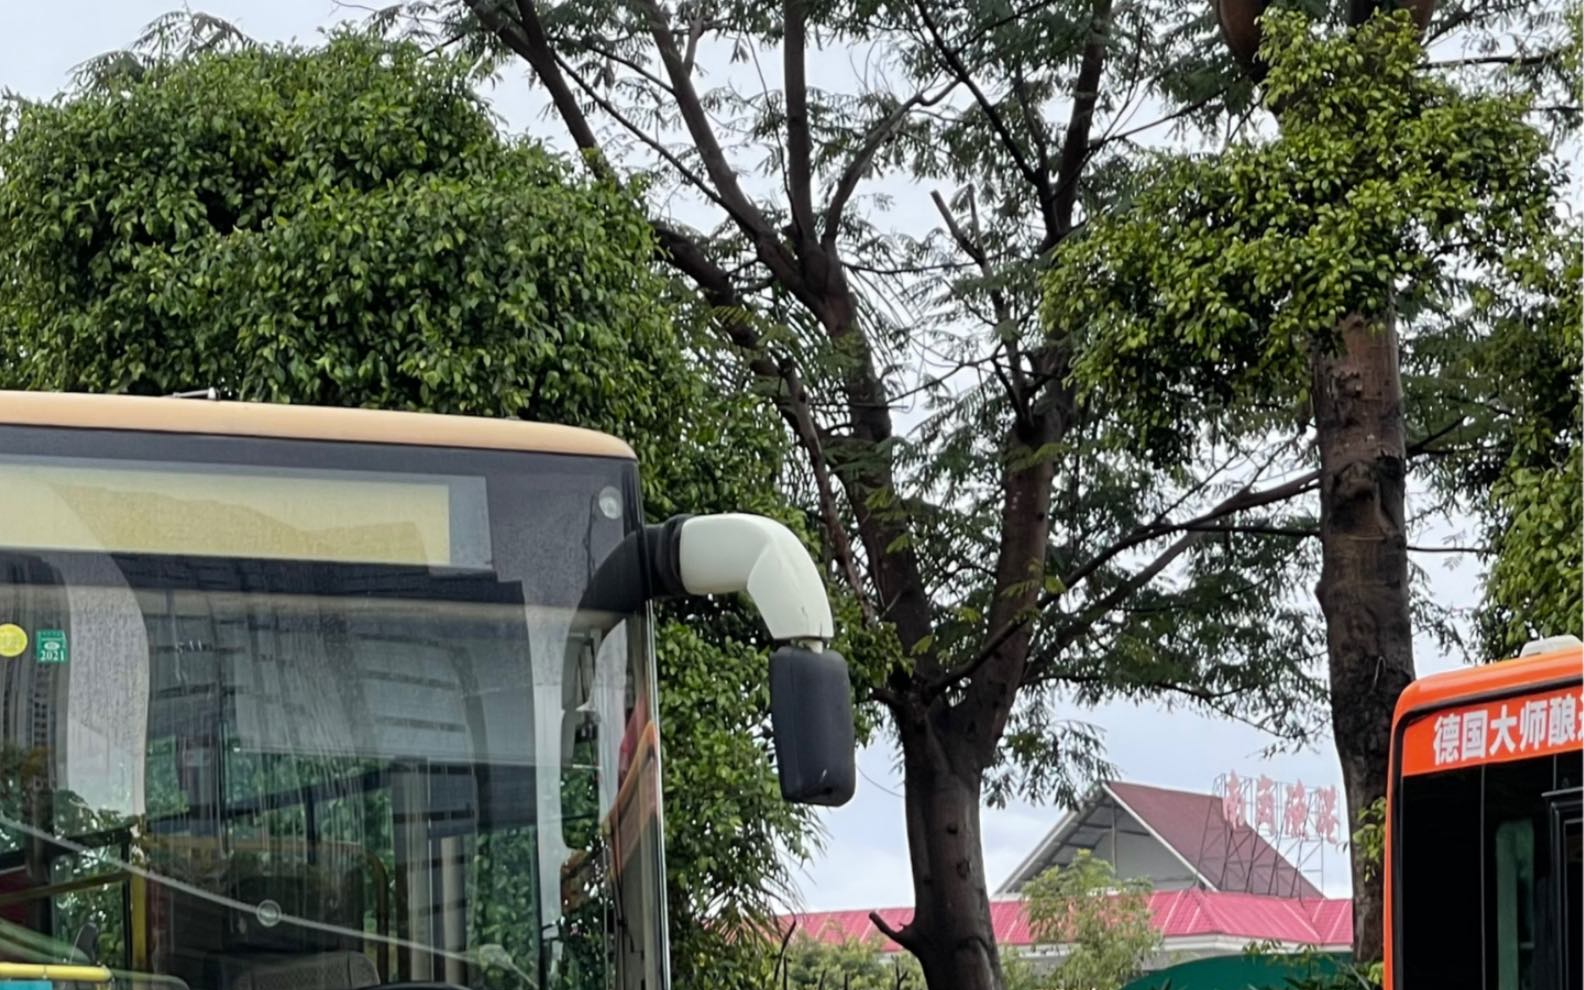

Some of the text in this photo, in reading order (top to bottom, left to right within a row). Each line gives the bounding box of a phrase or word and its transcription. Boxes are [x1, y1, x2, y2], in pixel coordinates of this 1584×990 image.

[39, 650, 65, 661] 2021
[1433, 693, 1584, 766] 德国大师酿
